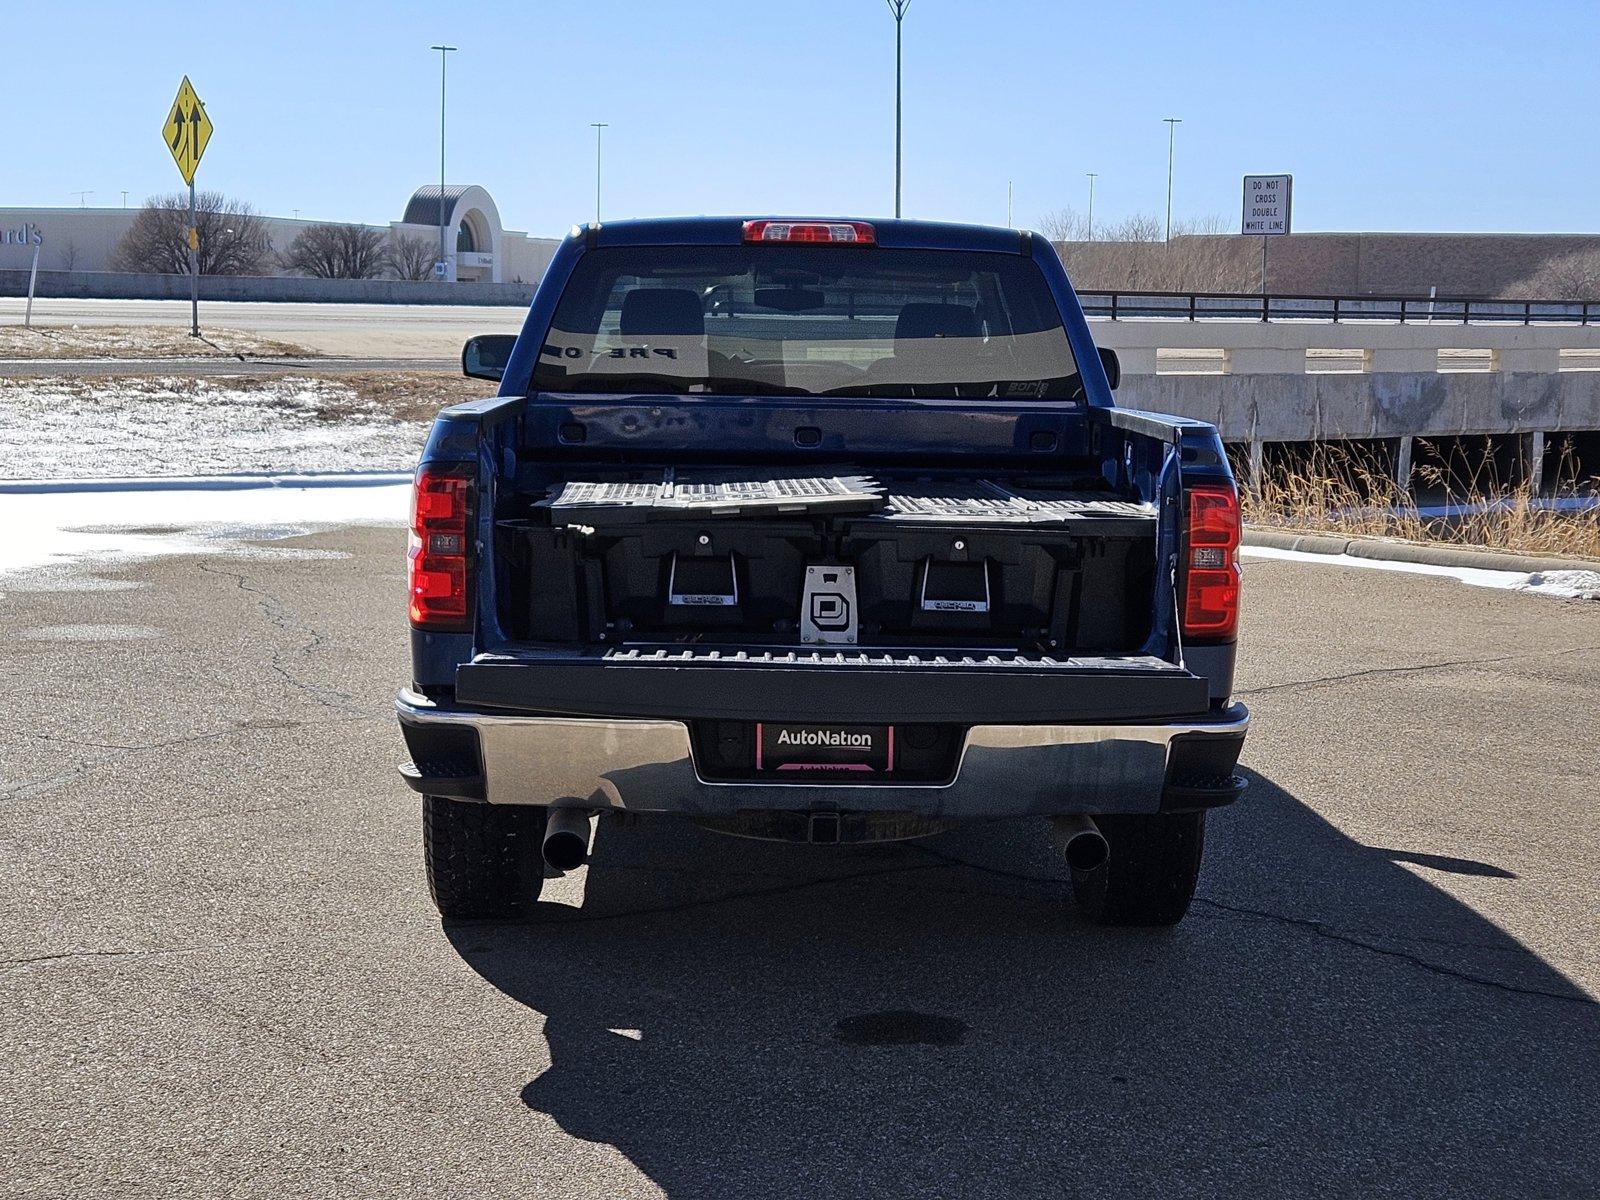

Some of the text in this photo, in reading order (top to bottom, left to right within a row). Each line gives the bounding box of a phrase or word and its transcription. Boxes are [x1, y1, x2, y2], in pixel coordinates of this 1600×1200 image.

[1253, 180, 1279, 190] DO NOT
[1255, 194, 1277, 203] CROSS
[1252, 207, 1278, 217] DOUBLE
[1245, 221, 1283, 230] WHITE LINE
[0, 223, 42, 245] rd's
[777, 729, 872, 746] AutoNation
